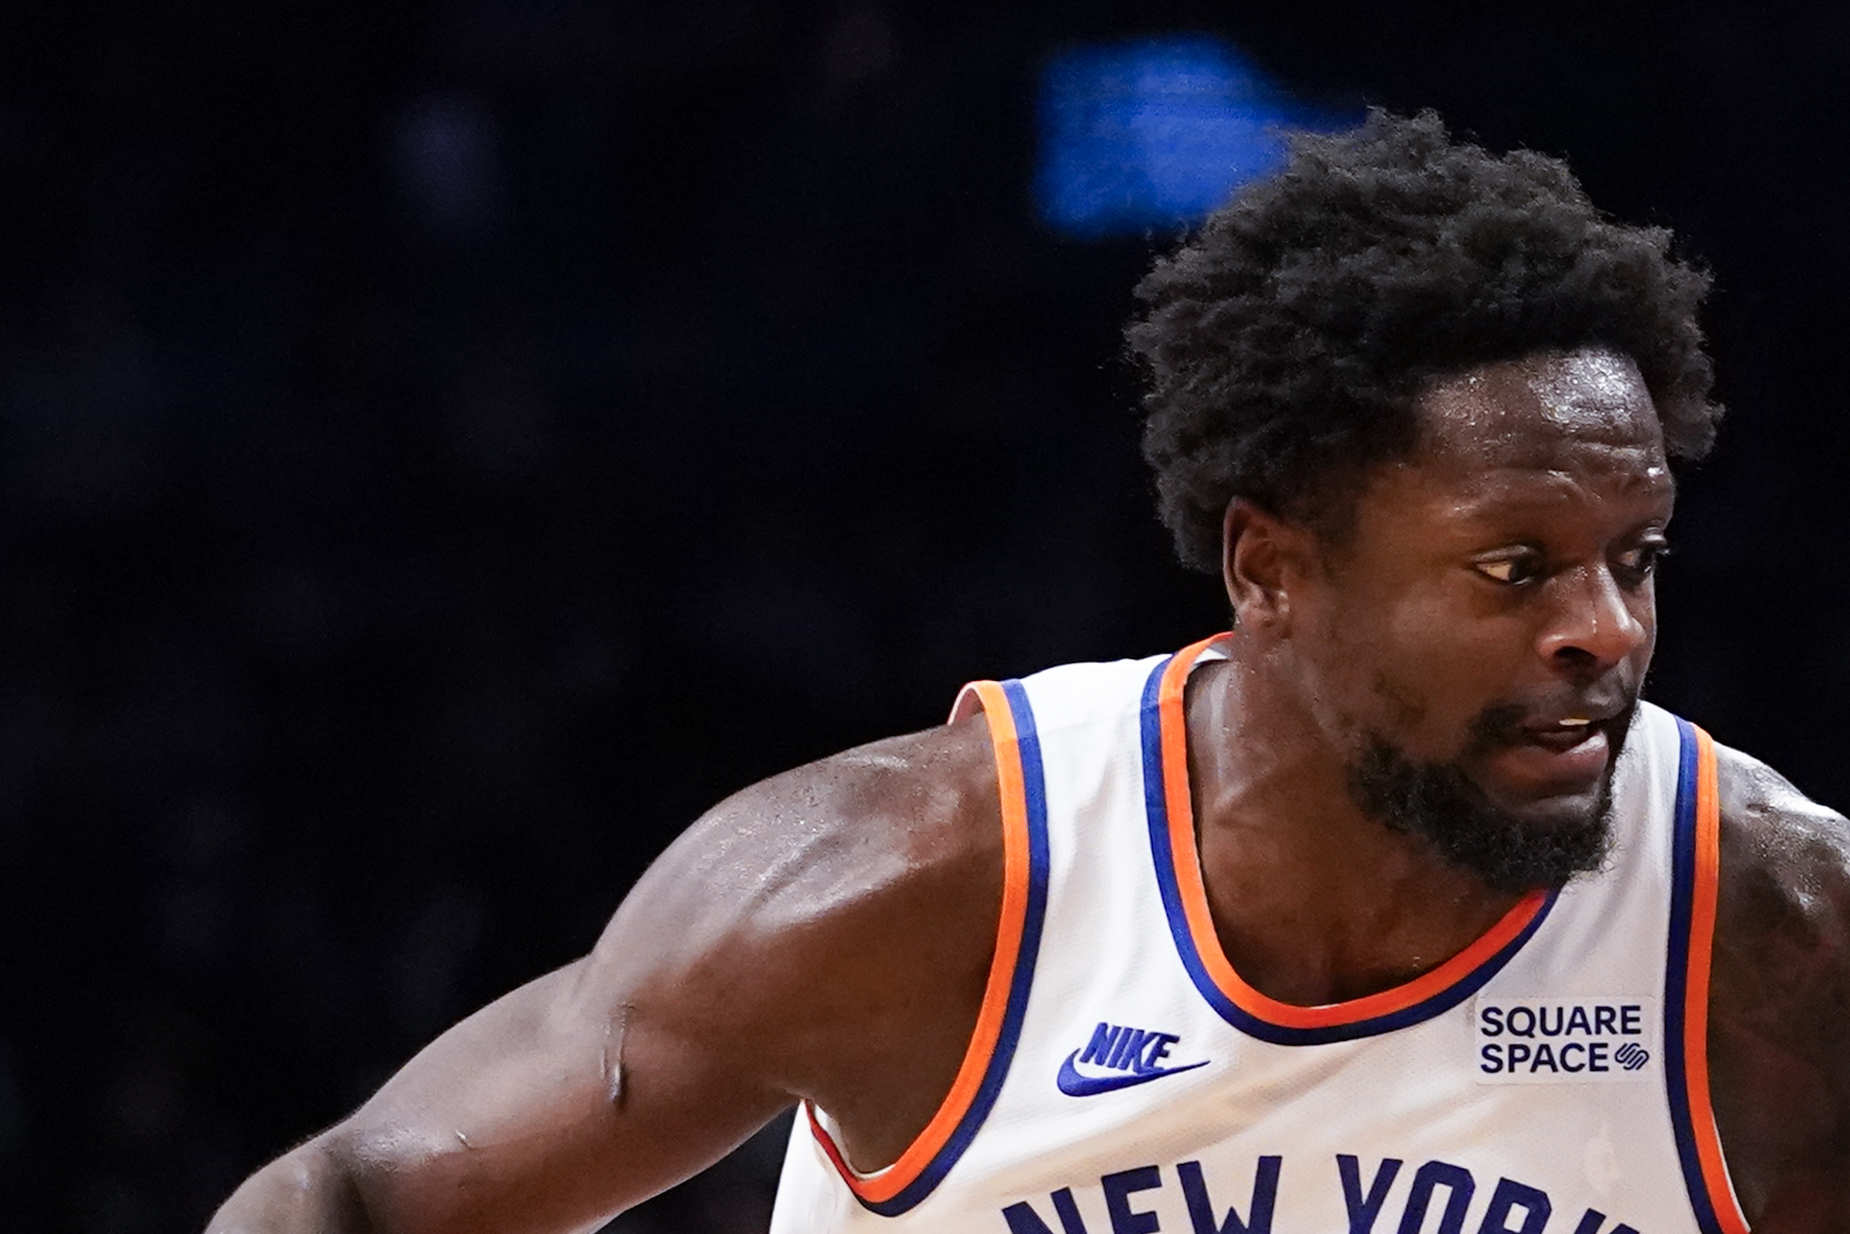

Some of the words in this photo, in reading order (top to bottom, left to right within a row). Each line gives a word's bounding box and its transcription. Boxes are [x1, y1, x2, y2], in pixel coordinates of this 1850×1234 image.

[1480, 1004, 1642, 1040] SQUARE
[1081, 1021, 1182, 1074] NIKE
[1480, 1042, 1610, 1075] SPACE
